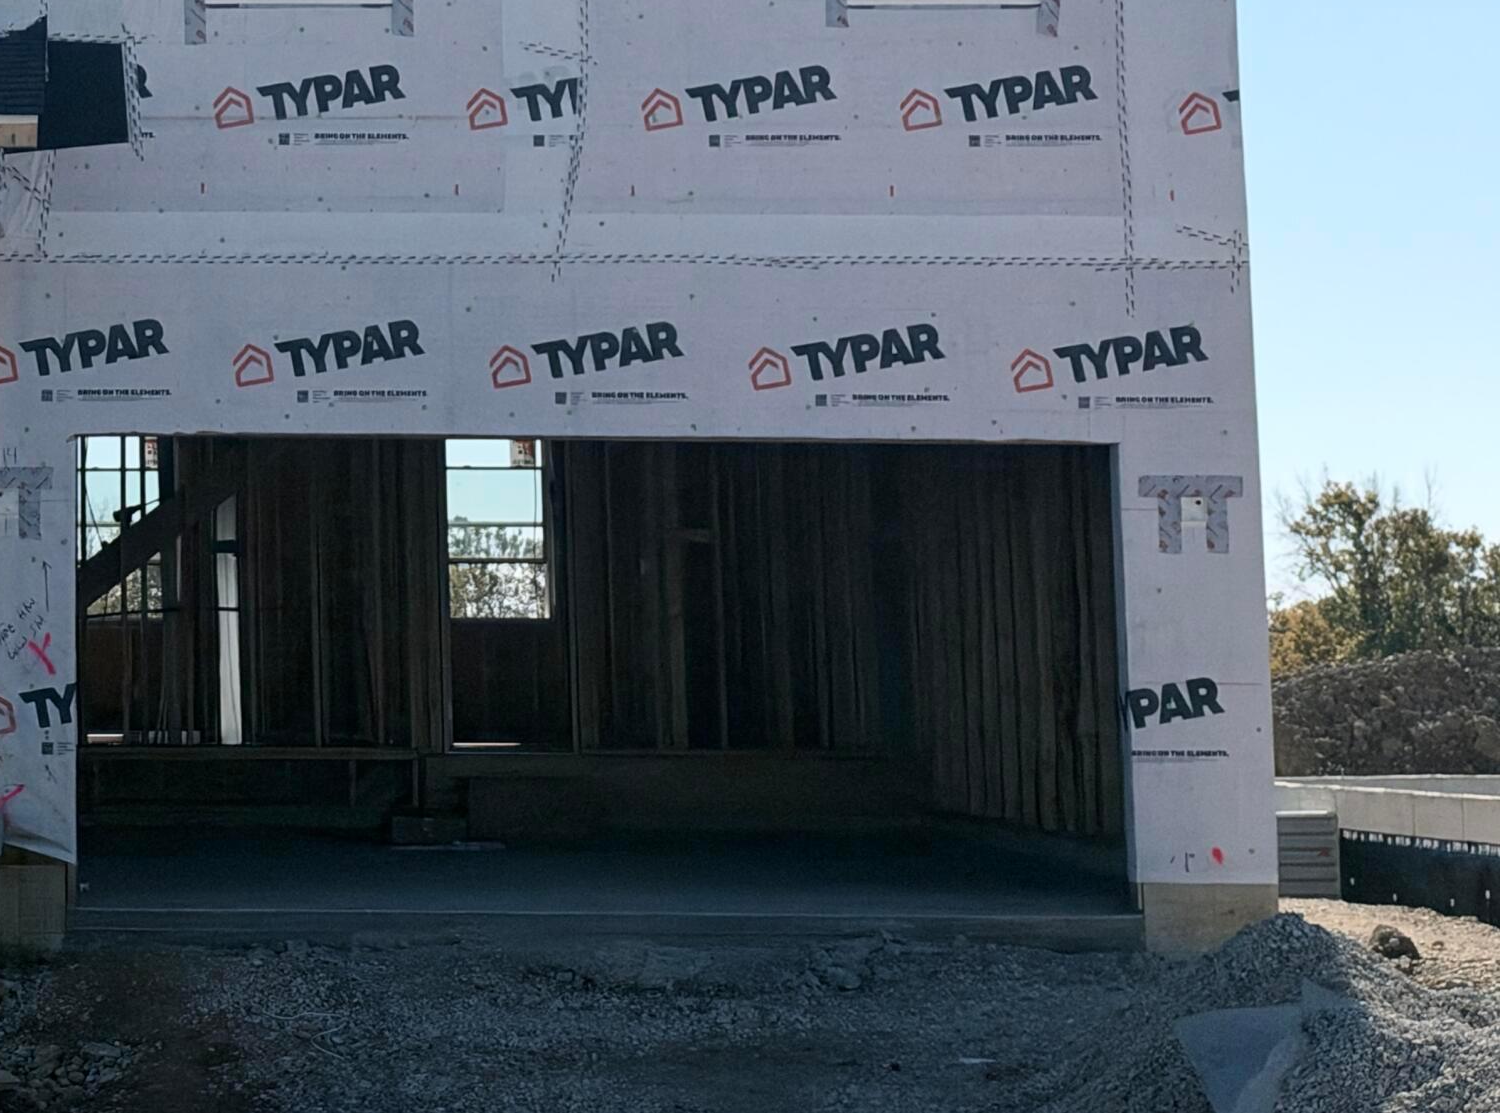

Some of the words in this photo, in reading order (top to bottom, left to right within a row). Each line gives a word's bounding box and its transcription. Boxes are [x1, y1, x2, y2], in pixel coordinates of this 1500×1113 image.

[256, 65, 405, 120] TYPAR
[685, 66, 836, 122] TYPAR
[944, 66, 1097, 122] TYPAR
[19, 319, 169, 376] TYPAR
[276, 320, 425, 377] TYPAR
[531, 322, 684, 378] TYPAR
[791, 324, 945, 380] TYPAR
[1053, 325, 1208, 383] TYPAR
[1118, 677, 1224, 731] PAR
